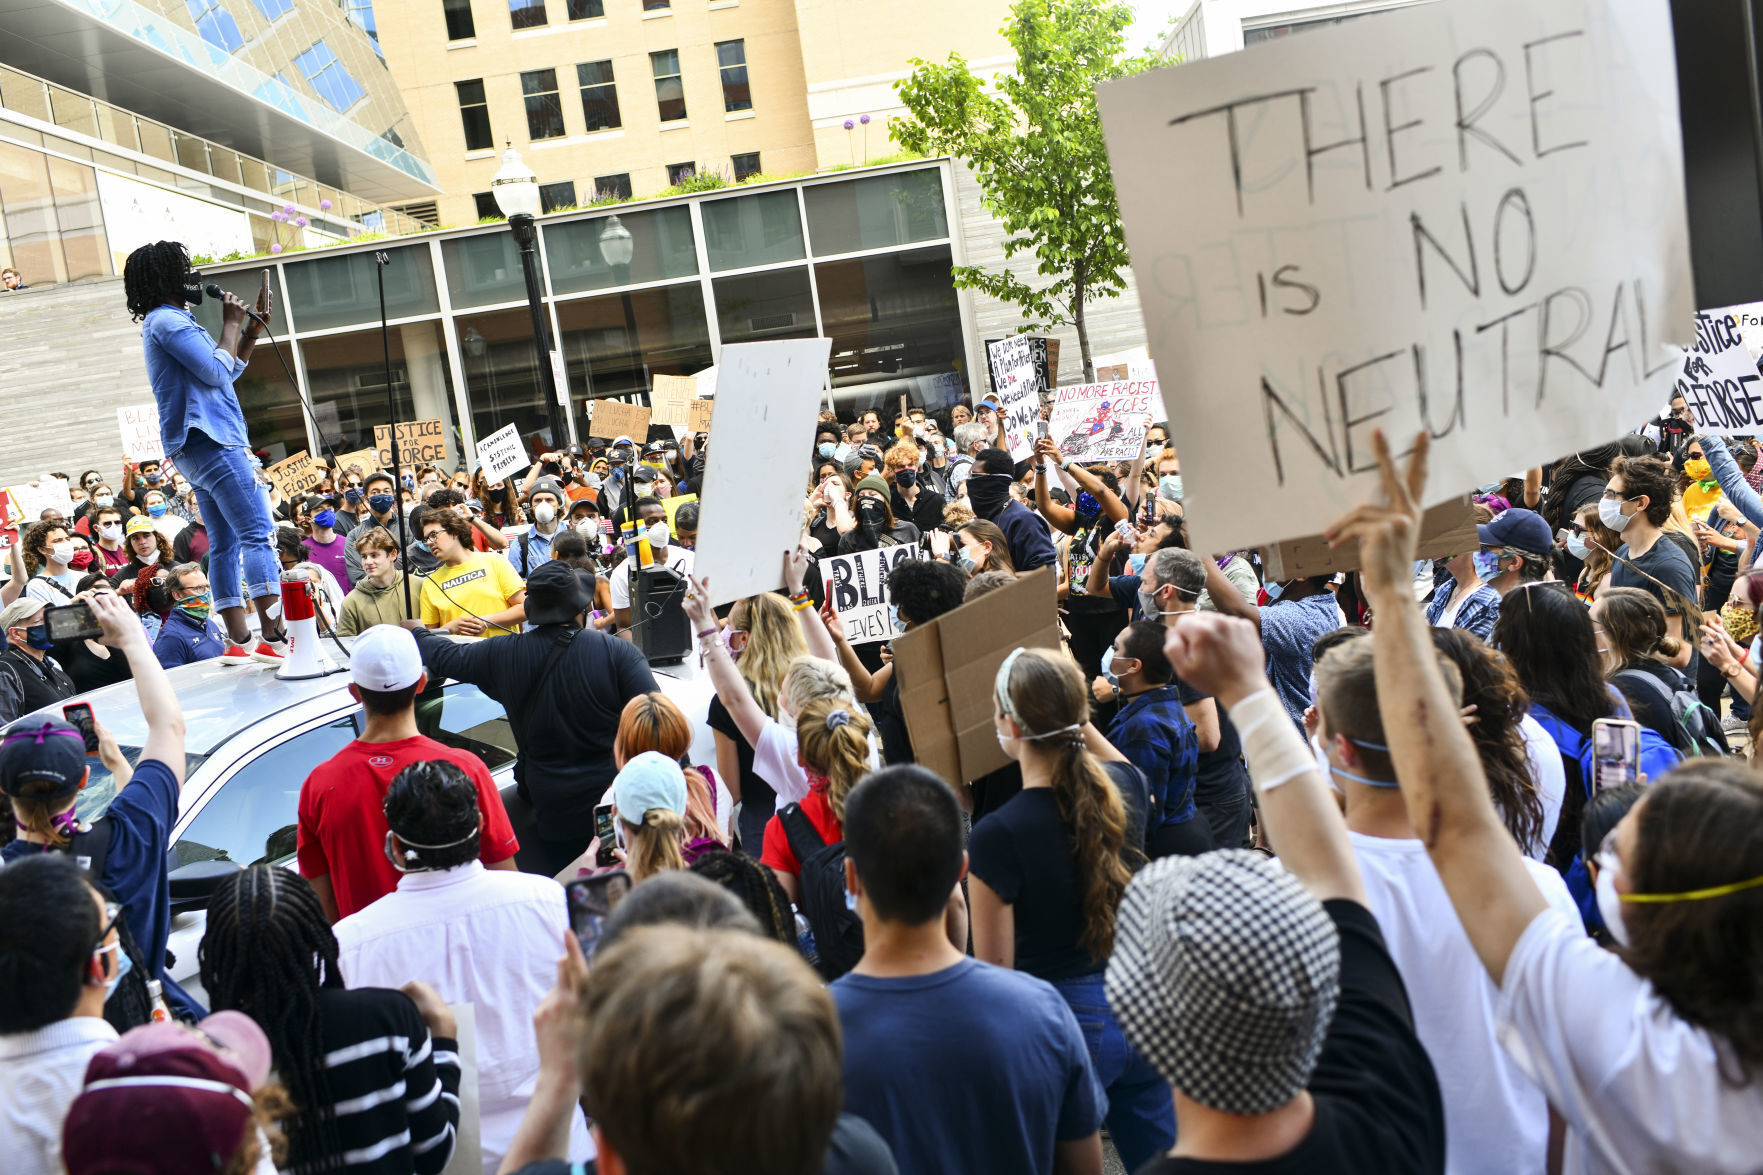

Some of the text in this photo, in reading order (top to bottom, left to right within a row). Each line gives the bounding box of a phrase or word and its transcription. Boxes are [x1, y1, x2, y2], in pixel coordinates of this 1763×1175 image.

[1168, 30, 1589, 218] THERE
[1257, 187, 1536, 317] IS NO
[1741, 314, 1763, 327] Fo
[1058, 381, 1157, 402] NO MORE RACIST
[1260, 279, 1682, 488] NEUTRAL
[1678, 375, 1763, 429] GEORGE
[125, 408, 157, 424] BLA
[653, 406, 690, 424] VIOLEN
[136, 425, 161, 438] LIV
[1122, 436, 1142, 445] COPS
[1128, 427, 1142, 436] ALL
[132, 440, 162, 456] MAT
[380, 445, 445, 466] GORGE
[1100, 446, 1139, 457] ARE RACIST
[272, 455, 311, 481] JUSTICE
[283, 474, 318, 497] FLOYD
[442, 570, 485, 590] NAUTICA
[848, 609, 885, 640] IVES
